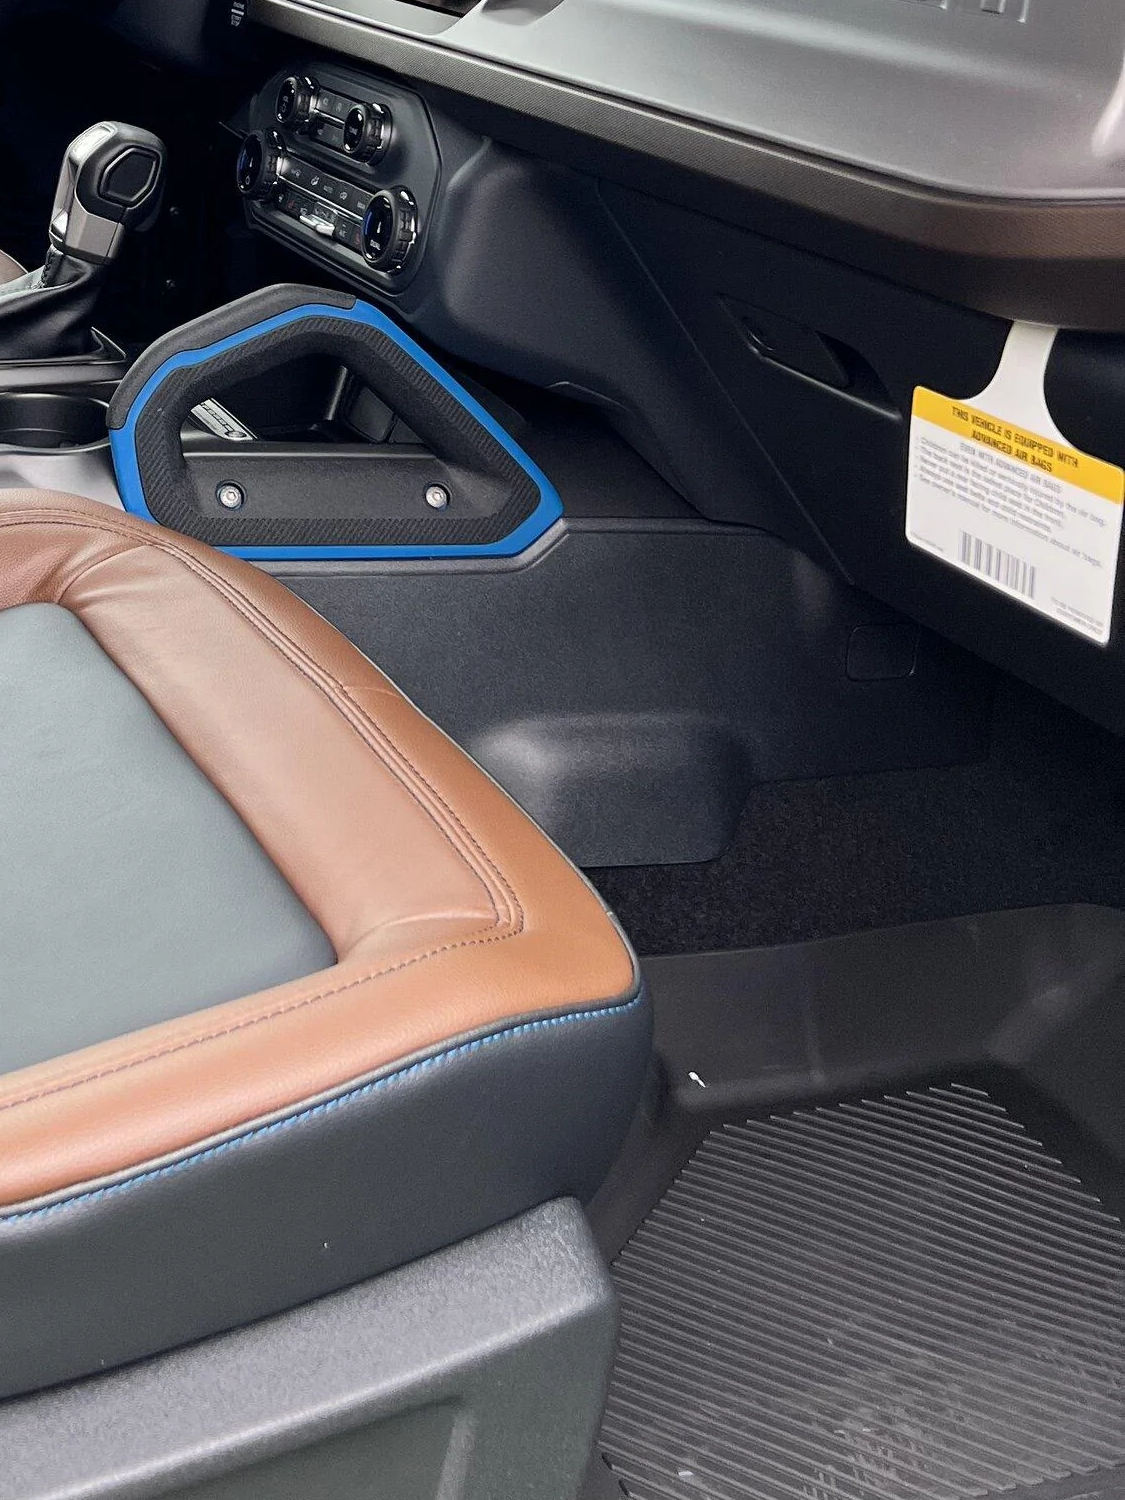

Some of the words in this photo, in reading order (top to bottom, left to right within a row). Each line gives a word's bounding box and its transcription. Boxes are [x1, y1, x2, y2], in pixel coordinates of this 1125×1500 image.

[951, 405, 969, 423] THIS
[970, 413, 1002, 437] VEHICLE
[1003, 427, 1012, 441] IS
[1013, 431, 1054, 458] EQUIPPED
[1056, 448, 1079, 469] WITH
[971, 429, 1012, 456] ADVANCED
[1014, 447, 1028, 463] AIR
[1030, 454, 1052, 473] BAGS
[959, 441, 976, 457] EVEN
[977, 449, 994, 465] WITH
[995, 456, 1028, 480] ADVANCED
[1029, 472, 1041, 485] AIR
